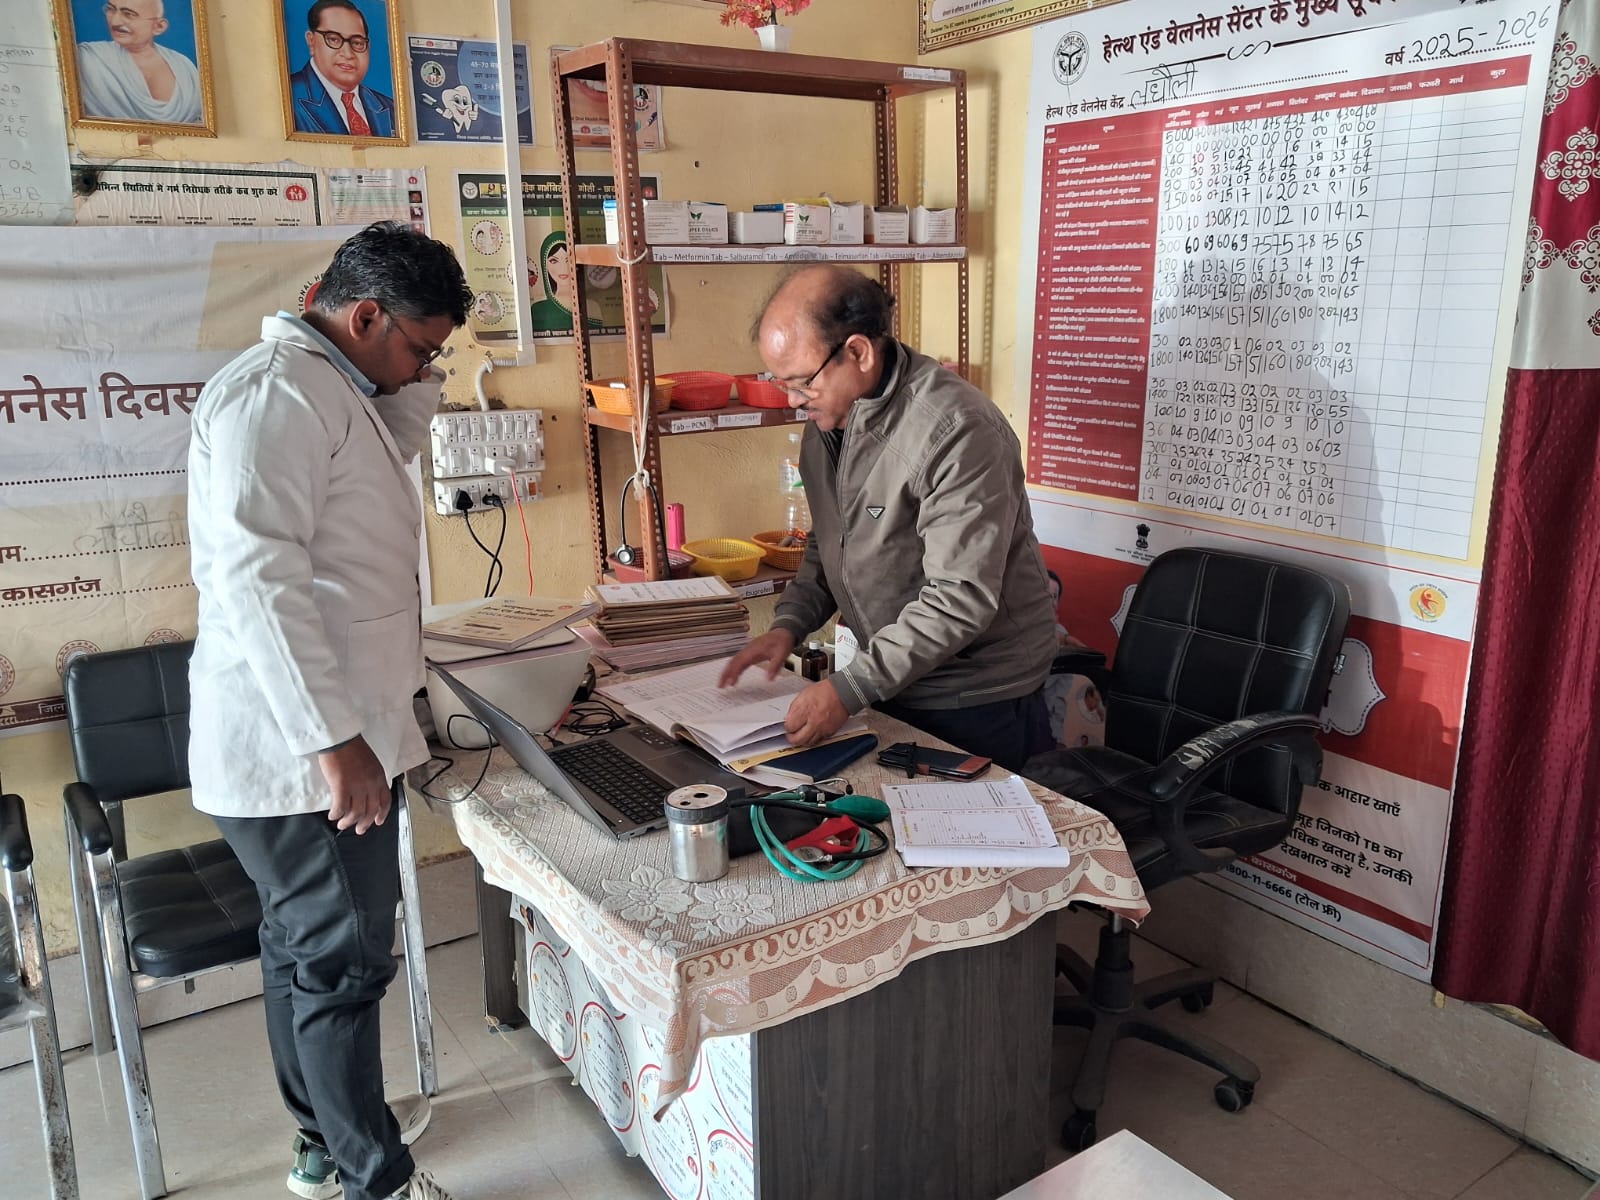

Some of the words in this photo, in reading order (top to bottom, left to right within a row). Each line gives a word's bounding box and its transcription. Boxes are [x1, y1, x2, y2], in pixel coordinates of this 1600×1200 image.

[1103, 34, 1135, 63] हेल्थ
[1140, 26, 1161, 54] एंड
[1166, 13, 1220, 45] वेलनेस
[1227, 4, 1265, 33] सेंटर
[1269, 0, 1291, 23] के
[1385, 46, 1405, 66] वर्ष
[1046, 105, 1063, 119] हेल्थ
[1066, 101, 1078, 116] एंड
[1081, 98, 1107, 113] वेलनेस
[1277, 181, 1298, 201] 20
[1304, 206, 1319, 225] 10
[1185, 237, 1199, 253] 60
[1231, 234, 1248, 251] 69
[1346, 232, 1364, 251] 65
[674, 253, 709, 261] Metformin
[672, 423, 685, 431] Tab
[692, 421, 706, 429] PCM
[1, 576, 101, 602] कासगंज
[1335, 784, 1370, 806] आहार
[1316, 817, 1360, 845] जिनको
[1363, 839, 1380, 853] TB
[1383, 845, 1403, 862] का
[1279, 840, 1328, 869] देखभाल
[1331, 862, 1352, 879] करें
[1322, 840, 1355, 863] खतरा
[1373, 860, 1413, 886] उनकी
